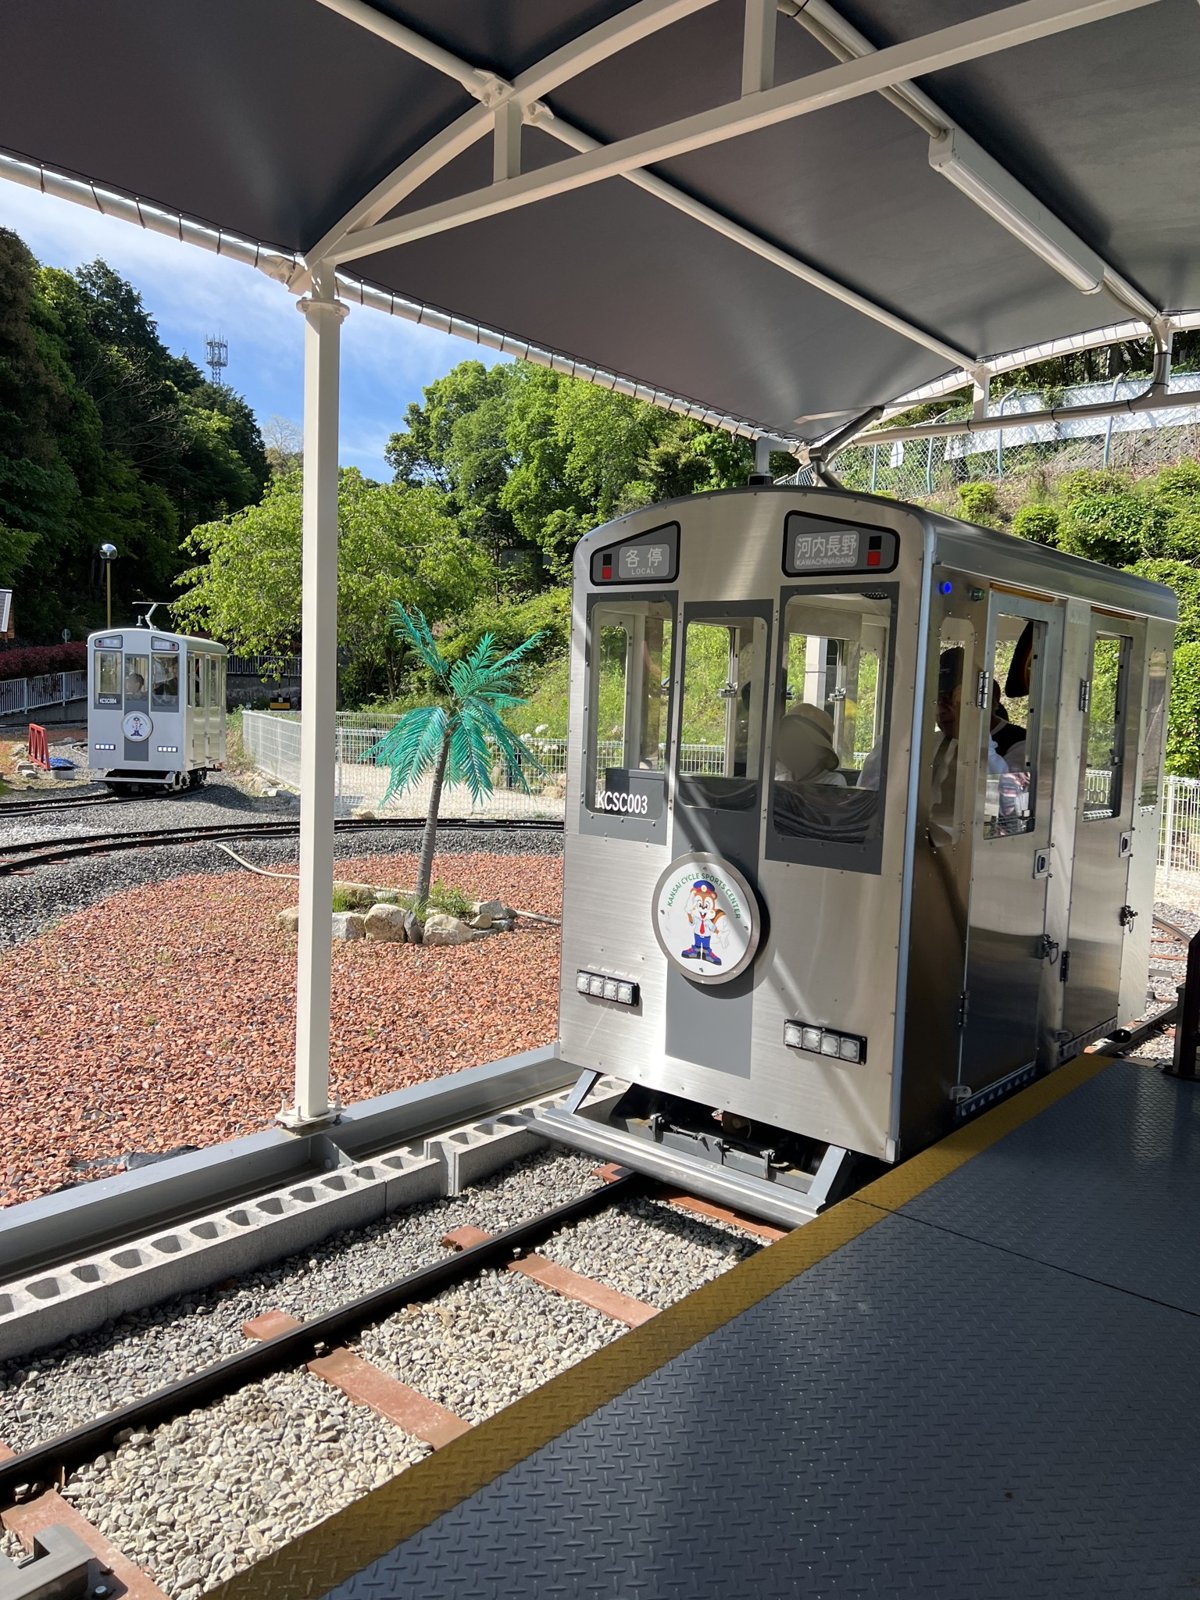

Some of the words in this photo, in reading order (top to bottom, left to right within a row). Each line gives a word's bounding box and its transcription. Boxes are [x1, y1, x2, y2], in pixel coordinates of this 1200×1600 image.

[625, 547, 663, 568] 各停
[797, 534, 857, 558] 河内長野
[631, 567, 656, 575] LOCAL
[597, 790, 648, 815] KCSC003
[667, 882, 682, 907] KANSAI
[681, 872, 700, 885] CYCLE
[701, 872, 726, 890] SPORTS
[725, 888, 741, 919] CENTER
